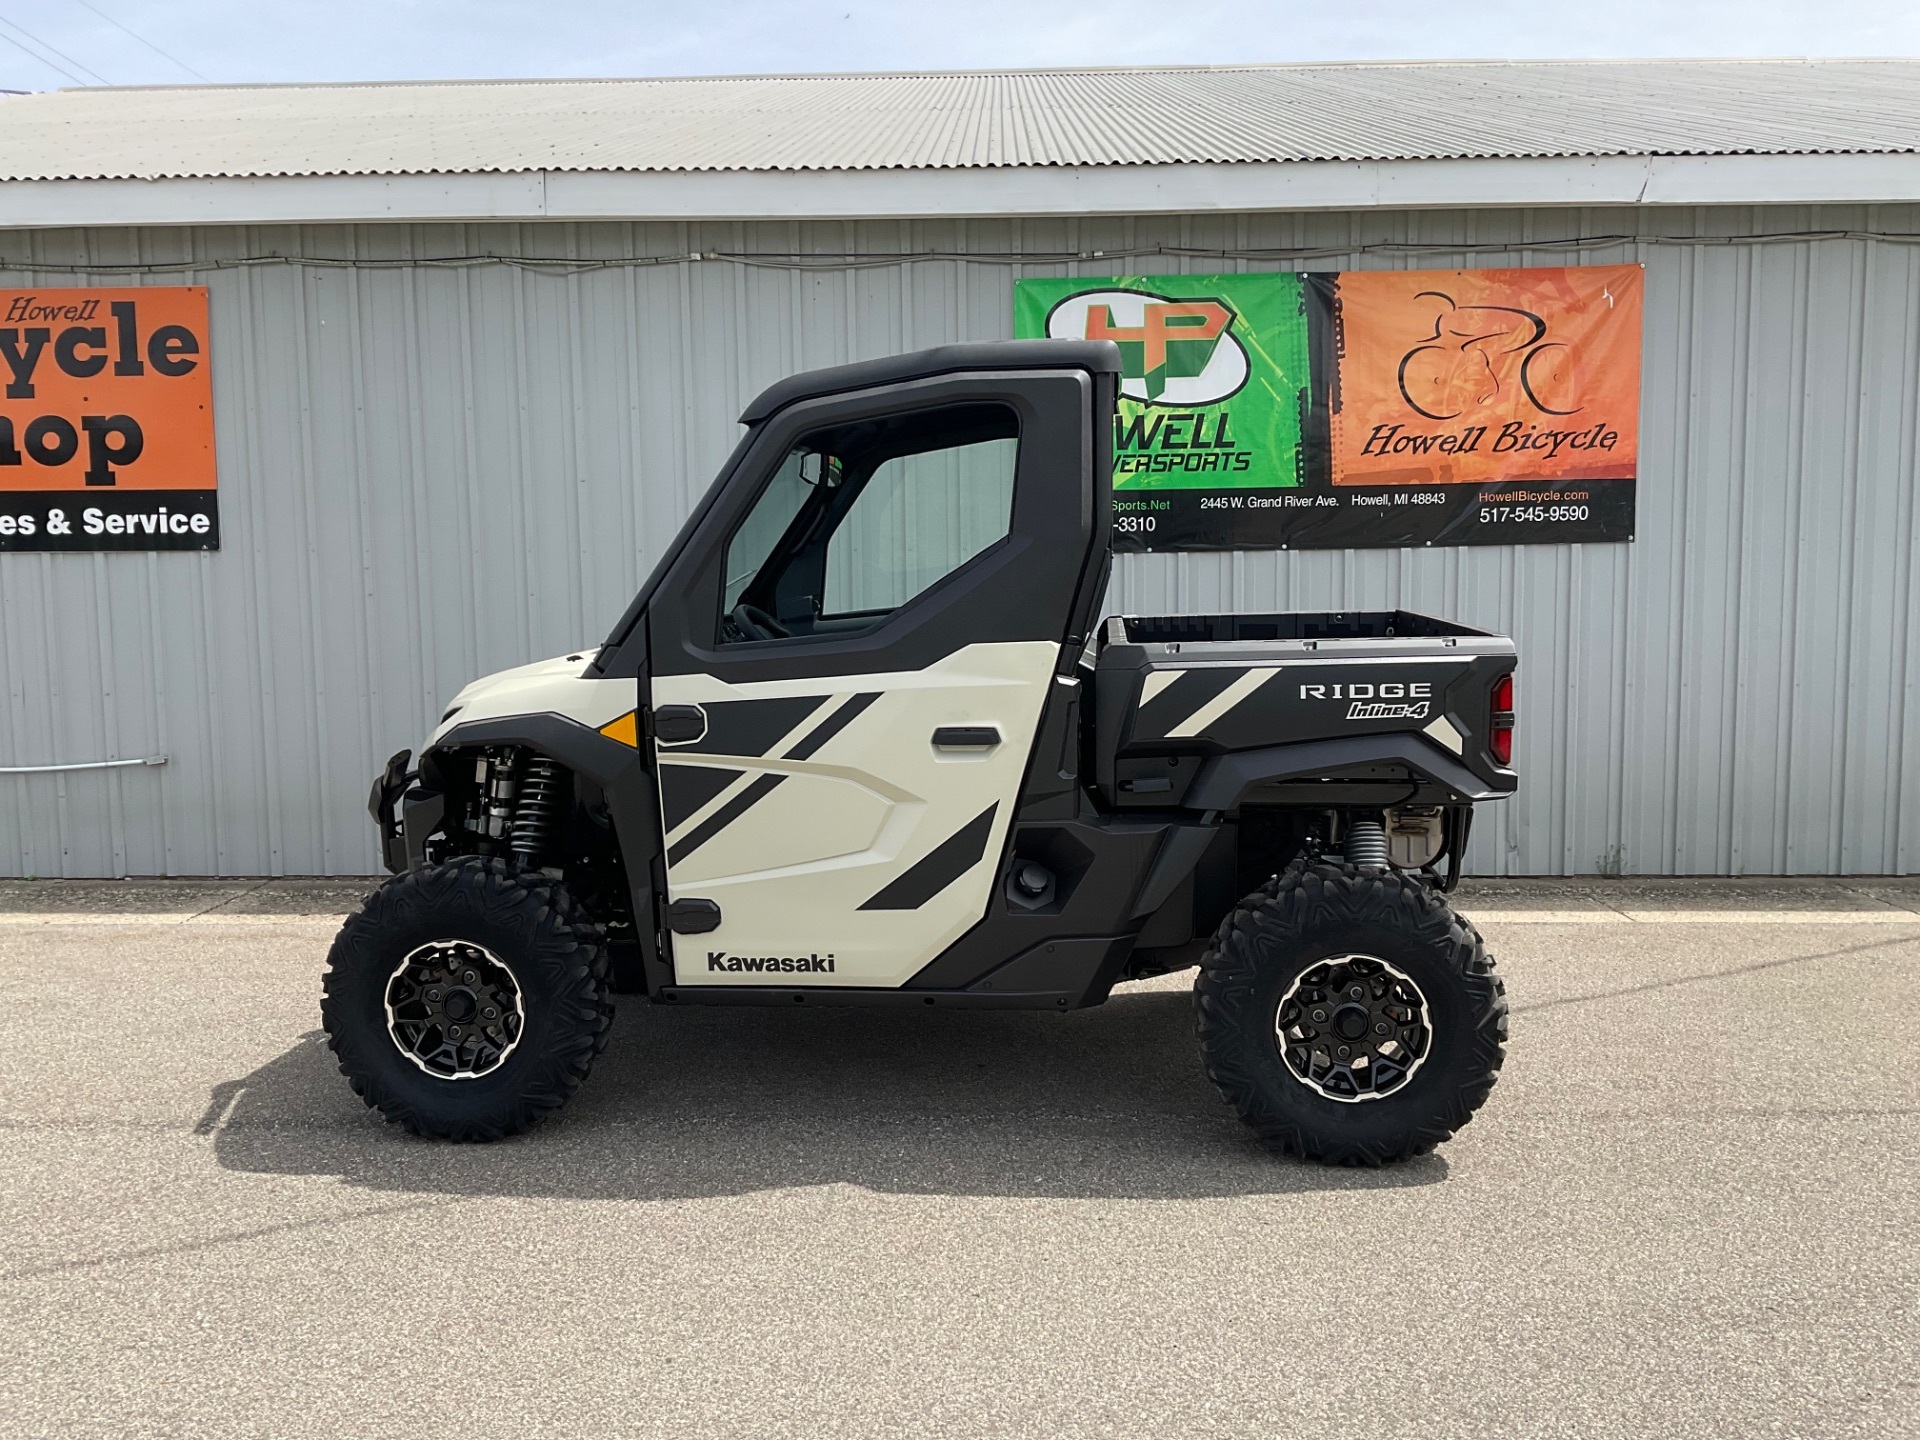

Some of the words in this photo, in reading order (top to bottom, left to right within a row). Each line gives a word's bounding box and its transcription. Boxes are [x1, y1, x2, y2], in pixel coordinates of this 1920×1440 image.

[5, 297, 100, 322] Howell
[0, 301, 200, 399] ycle
[1114, 413, 1236, 450] WELL
[1360, 424, 1488, 457] Howell
[1491, 421, 1619, 460] Bicycle
[1200, 497, 1229, 509] 2445
[1230, 496, 1245, 508] W.
[1247, 496, 1282, 508] Grand
[1284, 495, 1313, 507] River
[1315, 495, 1340, 507] Ave.
[1351, 494, 1391, 507] Howell,
[1394, 493, 1408, 505] MI
[1410, 493, 1446, 505] 48843
[1478, 490, 1589, 503] HowellBicycle.com
[46, 508, 72, 535] &
[83, 507, 210, 534] Service
[1479, 505, 1589, 523] 517-545-9590
[1300, 683, 1432, 699] RIDGE
[1346, 702, 1430, 719] Inline-4
[707, 952, 835, 973] Kawasaki
